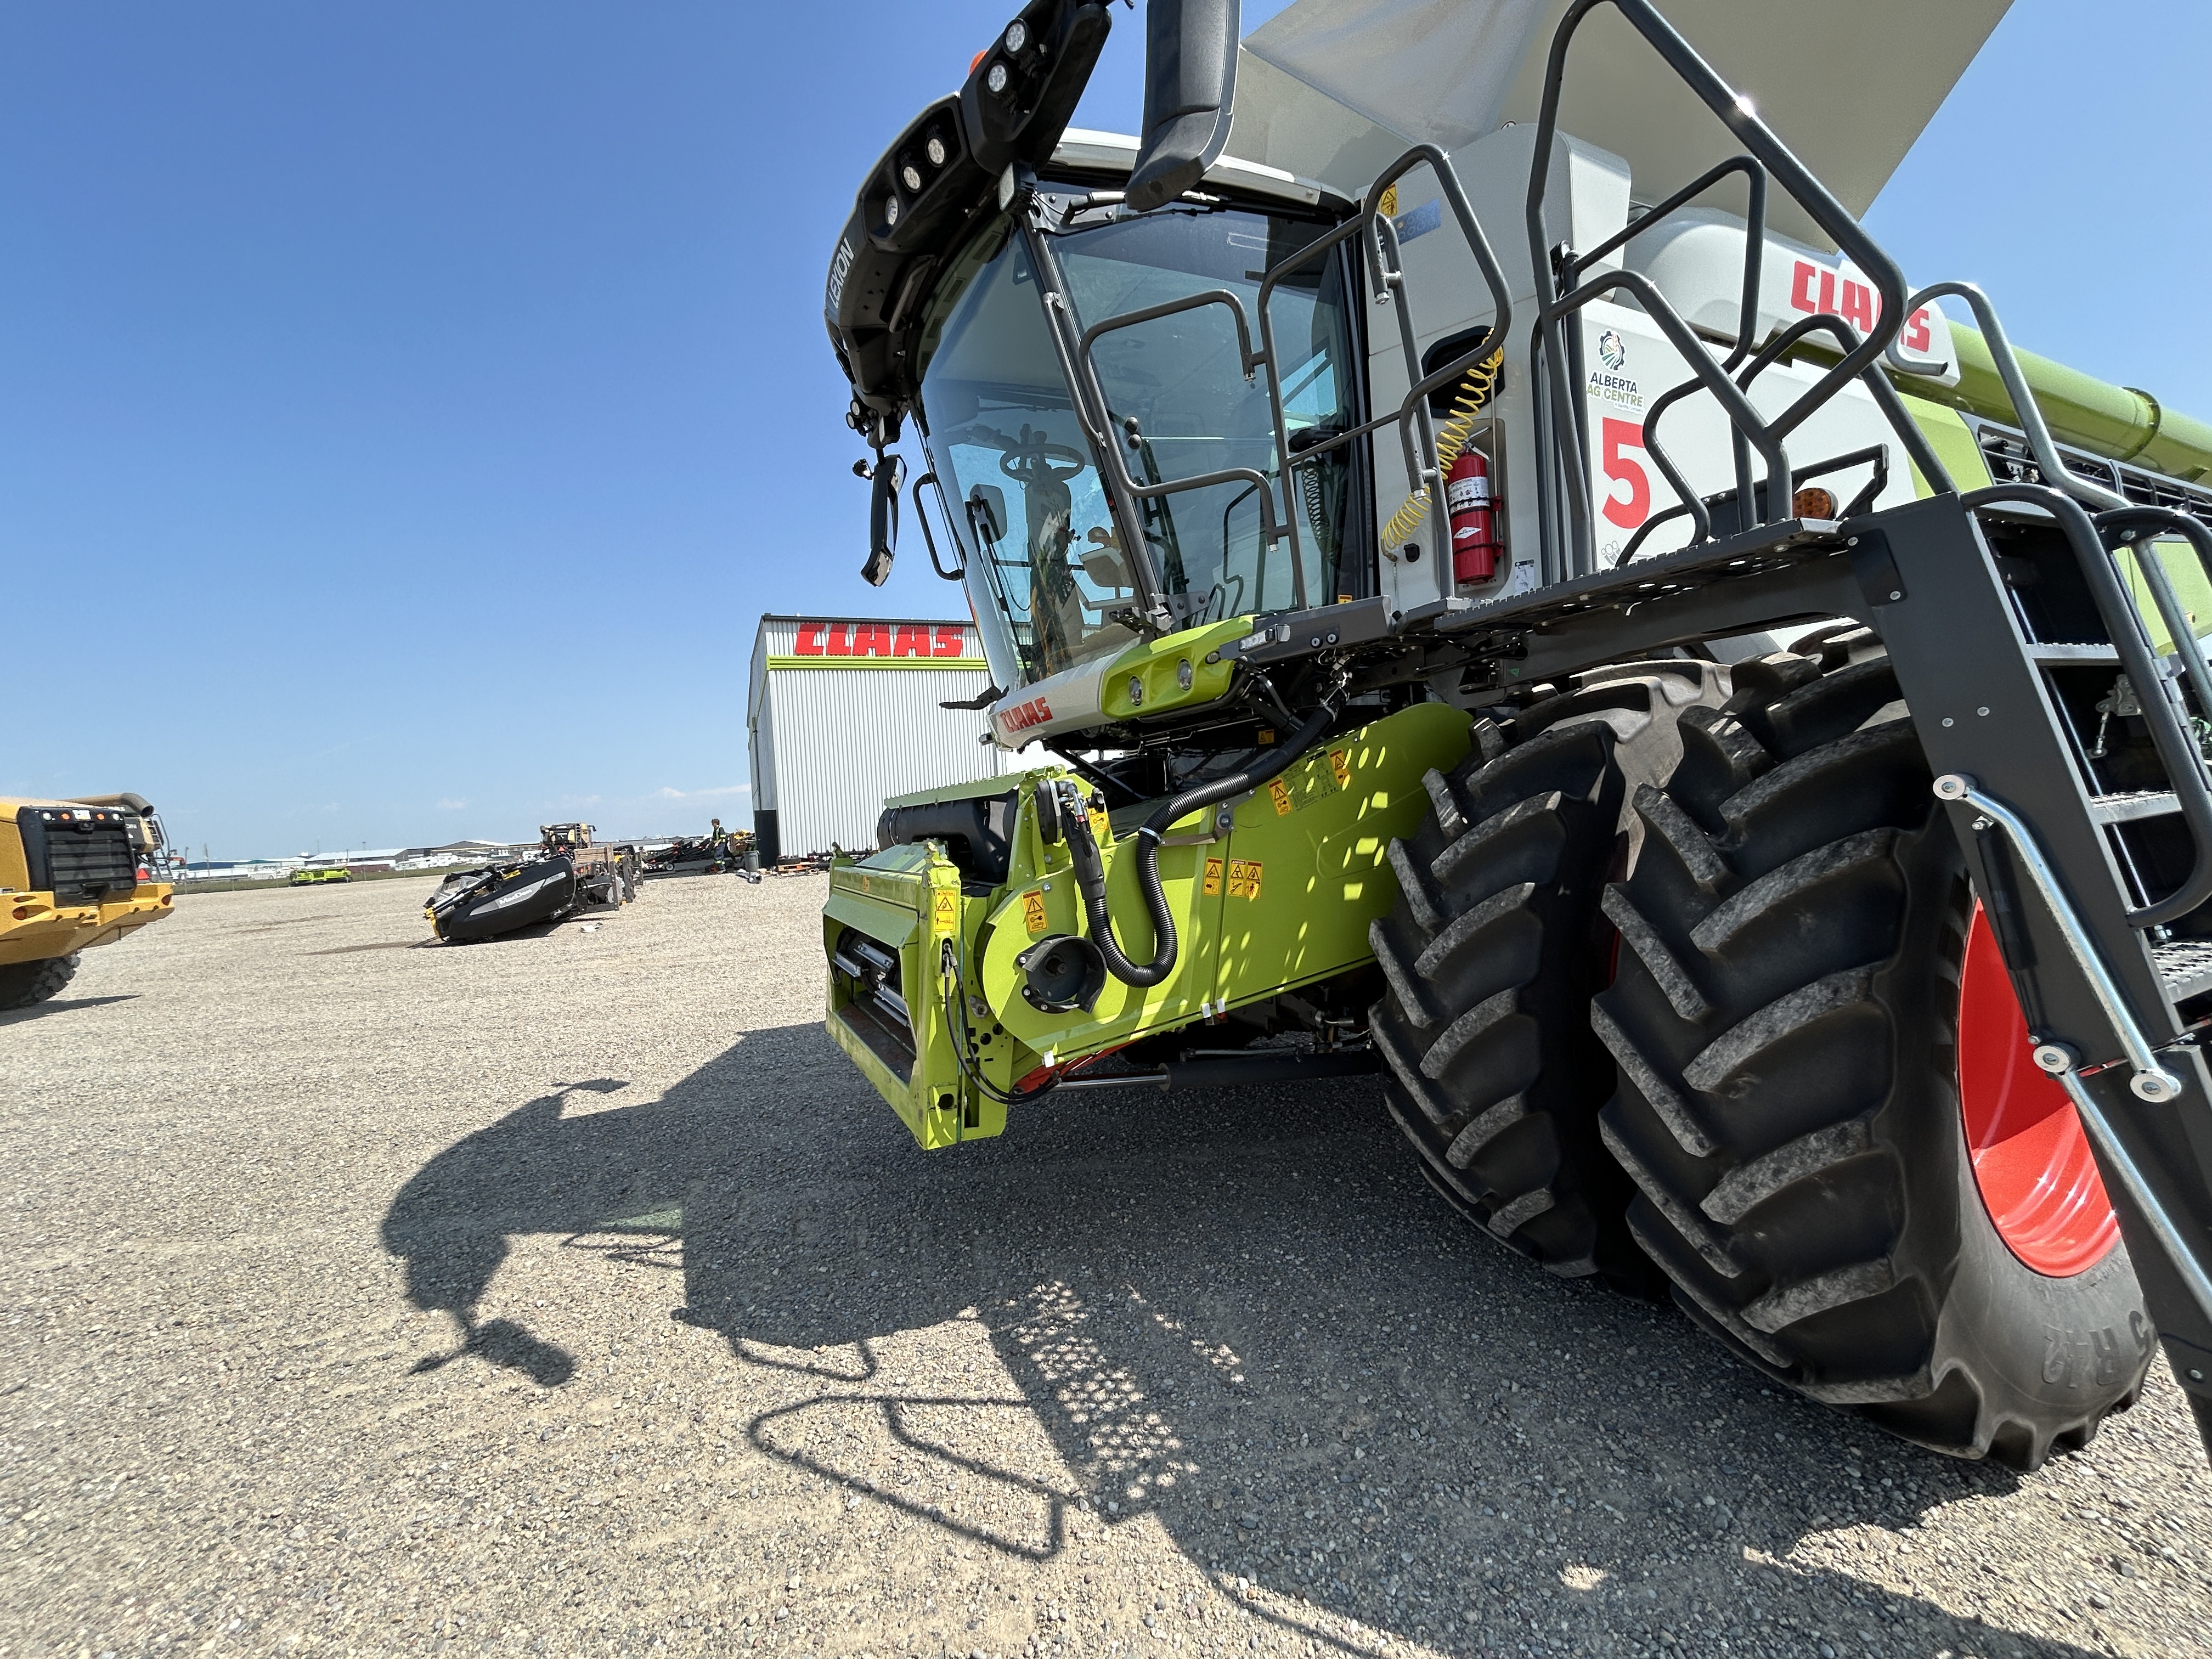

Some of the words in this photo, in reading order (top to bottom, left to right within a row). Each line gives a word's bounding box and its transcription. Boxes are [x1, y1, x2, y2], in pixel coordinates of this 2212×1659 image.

[828, 236, 854, 309] LEXION
[1791, 260, 1931, 353] CLAS
[1587, 384, 1601, 397] AG
[1604, 388, 1643, 407] CENTRE
[1590, 372, 1638, 394] ALBERTA
[1602, 417, 1650, 529] 5
[795, 622, 964, 657] CLAAS
[1000, 696, 1053, 733] CLAAS
[499, 889, 533, 905] MacDon
